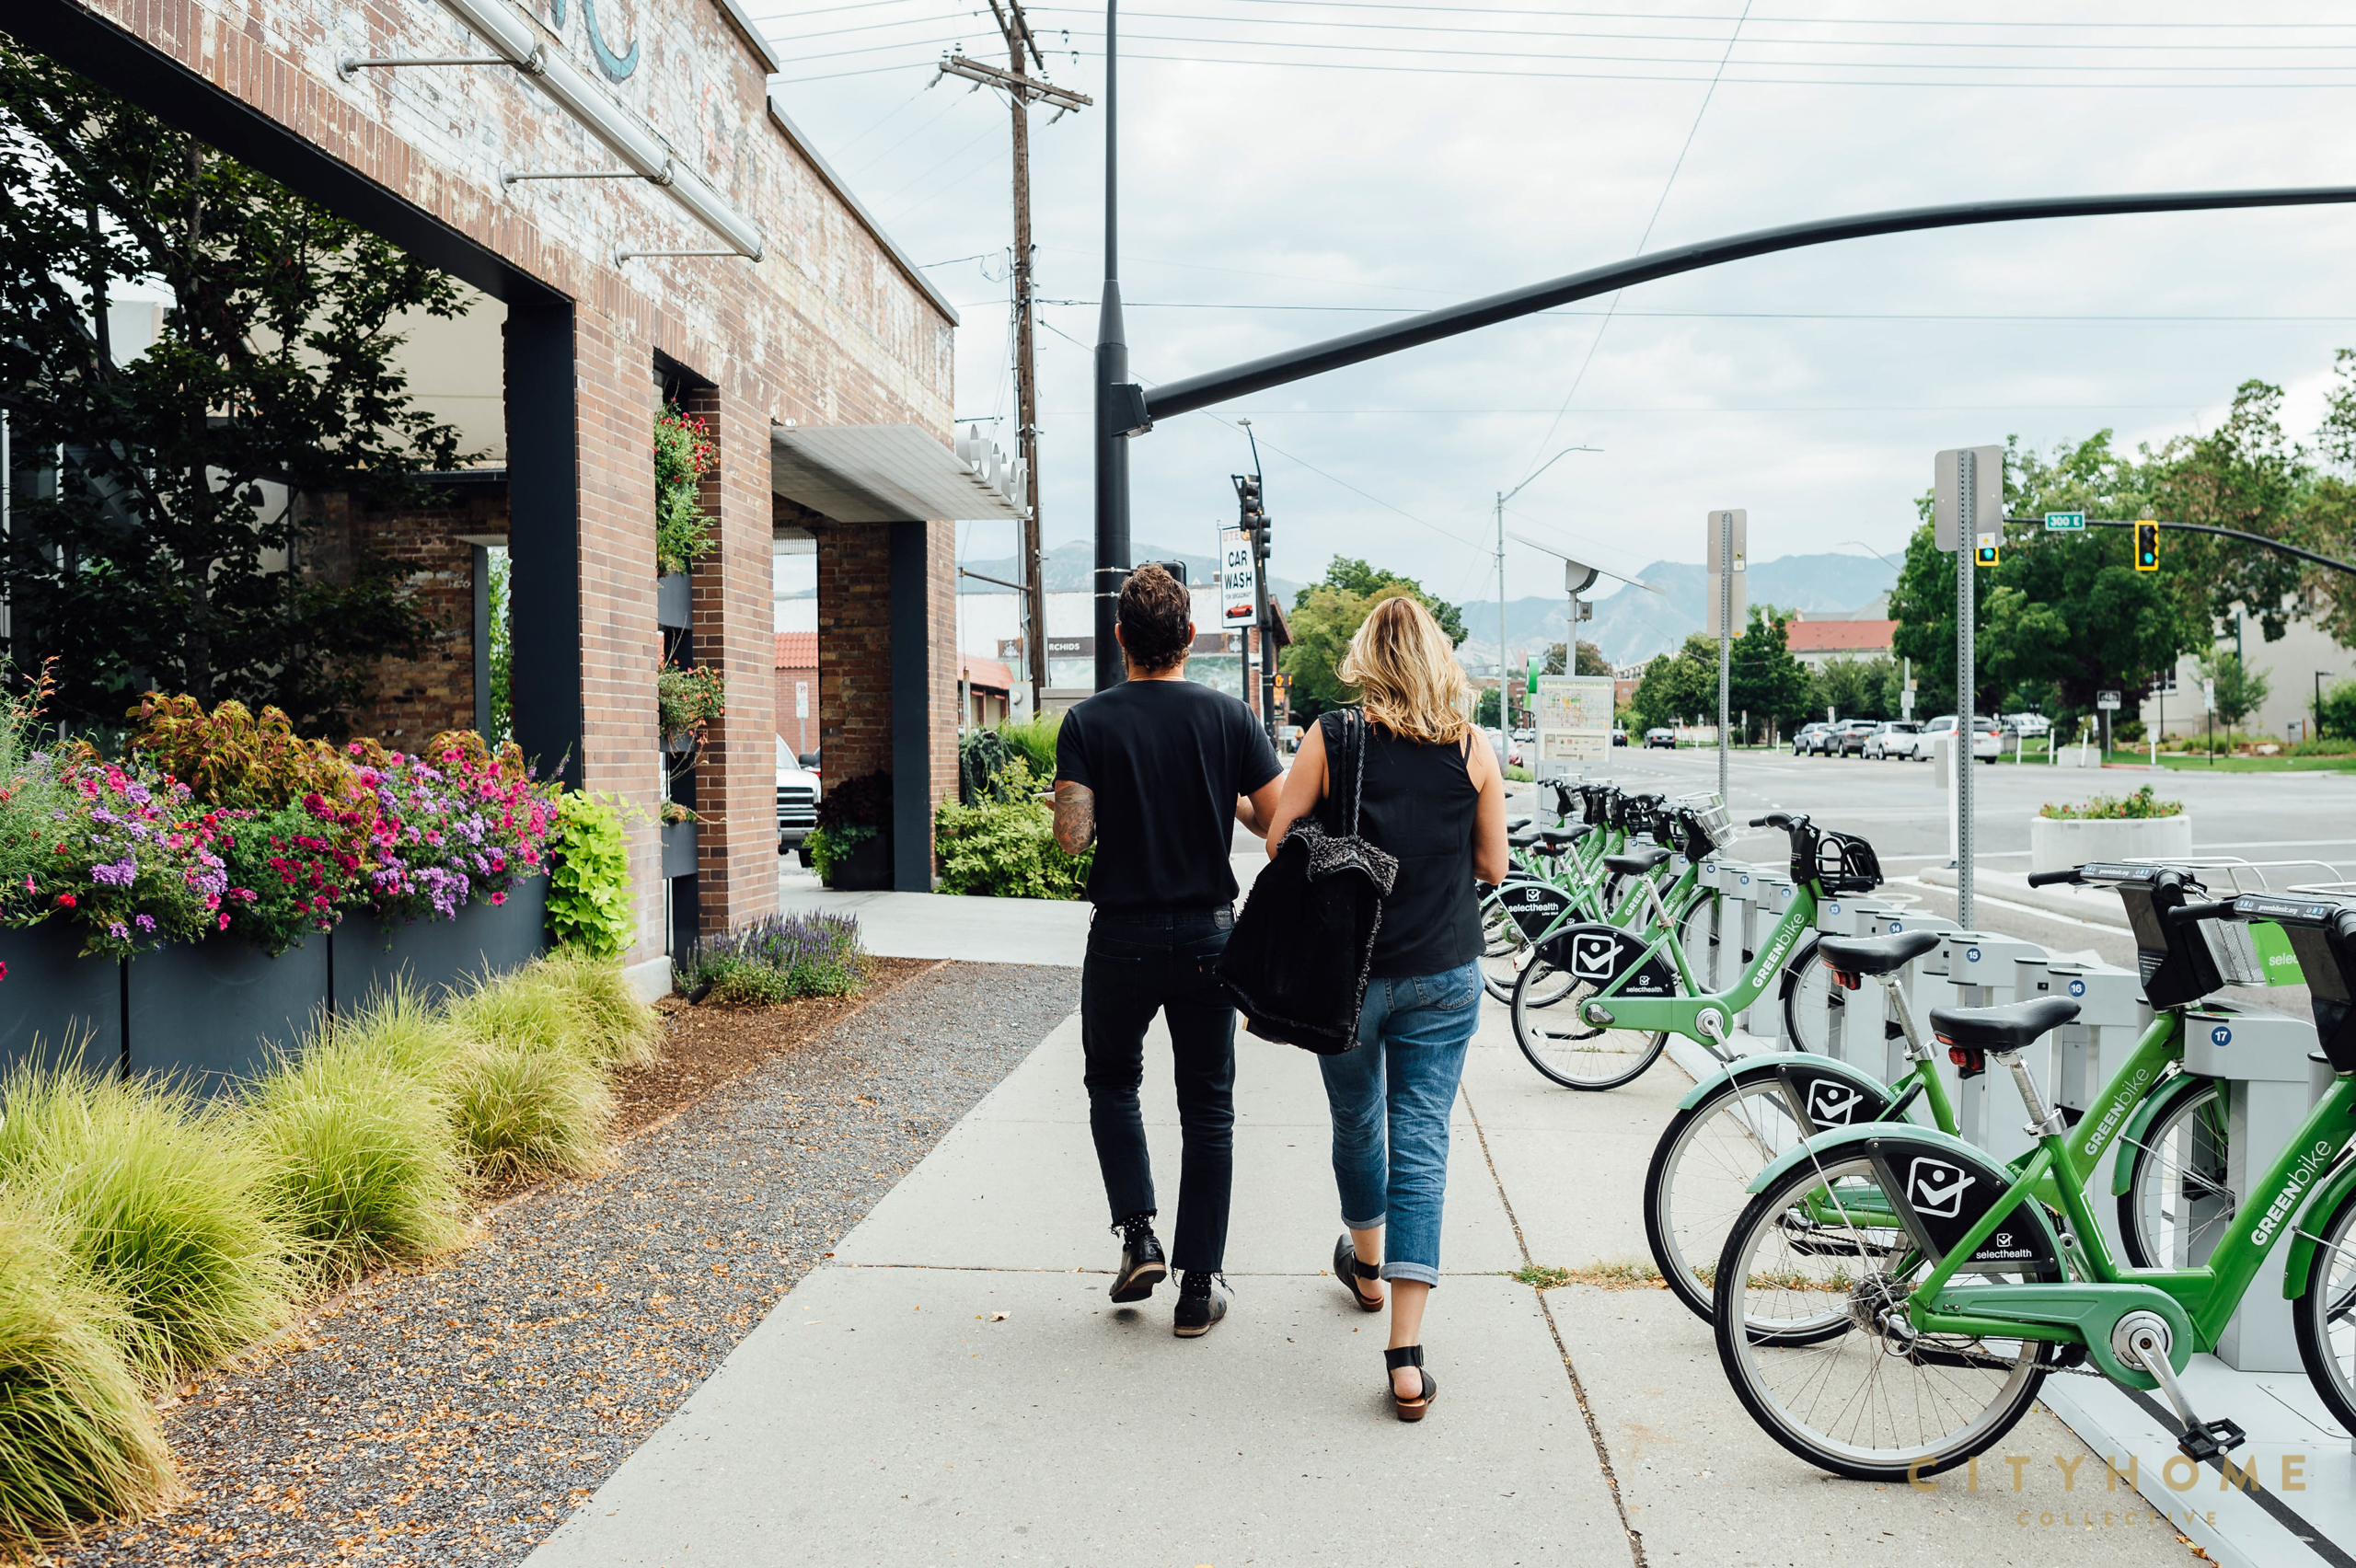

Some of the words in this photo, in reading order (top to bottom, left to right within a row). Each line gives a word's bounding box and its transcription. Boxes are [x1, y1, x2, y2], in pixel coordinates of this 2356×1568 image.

[2050, 516, 2070, 526] 300
[2073, 516, 2080, 526] E
[1222, 530, 1240, 541] UTE
[1228, 550, 1247, 567] CAR
[1224, 571, 1253, 589] WASH
[1048, 642, 1080, 651] RCHIDS
[1508, 903, 1559, 913] selecthealth
[1831, 905, 1840, 914] 13
[1752, 913, 1804, 988] GREENbike
[1969, 951, 1979, 960] 15
[2071, 985, 2083, 994] 16
[2215, 1031, 2228, 1042] 17
[2084, 1067, 2150, 1156] GREENbike
[2250, 1140, 2332, 1246] GREENbike
[1976, 1249, 2033, 1260] selecthealth
